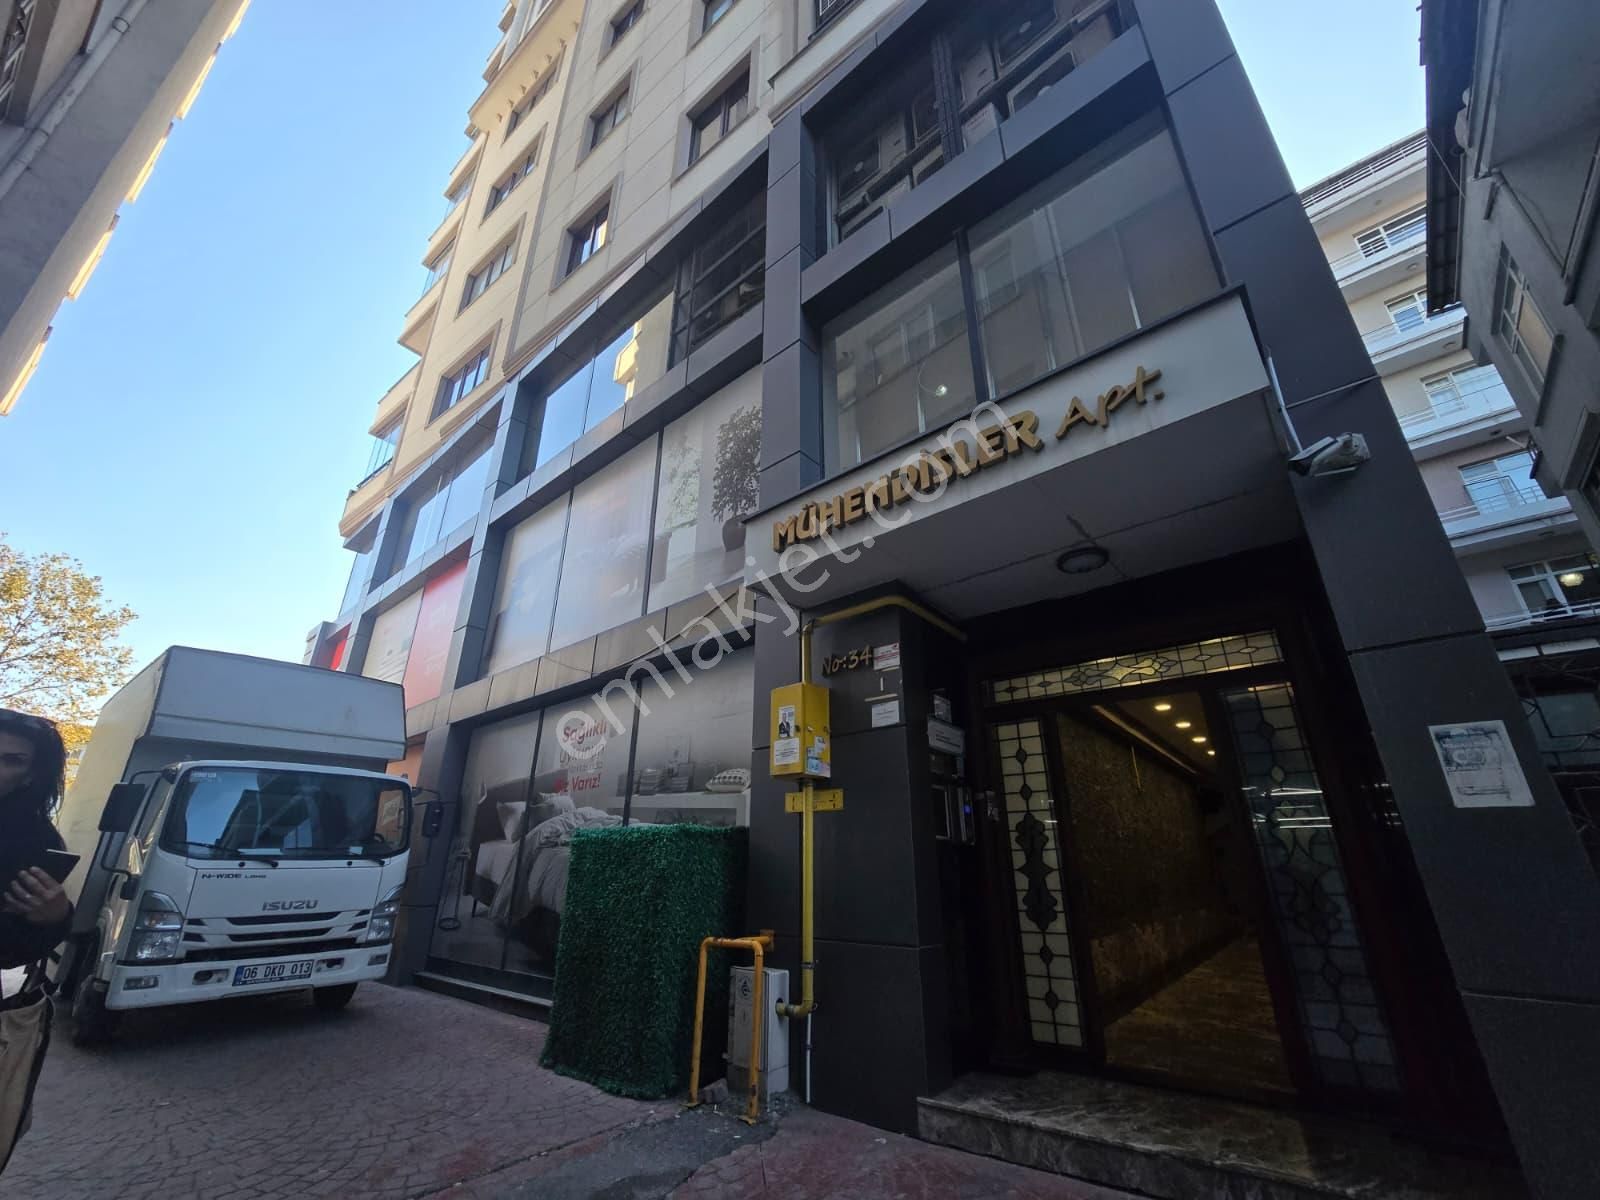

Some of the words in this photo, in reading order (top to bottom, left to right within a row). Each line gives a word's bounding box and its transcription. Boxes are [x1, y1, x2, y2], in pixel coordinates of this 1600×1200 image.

[772, 409, 1044, 553] MÜHENDİSLER
[1055, 365, 1165, 440] Apt.
[822, 644, 873, 677] No:34
[262, 899, 319, 912] ISUZU
[243, 967, 258, 979] 06
[264, 965, 285, 978] DKD
[291, 962, 311, 976] 013
